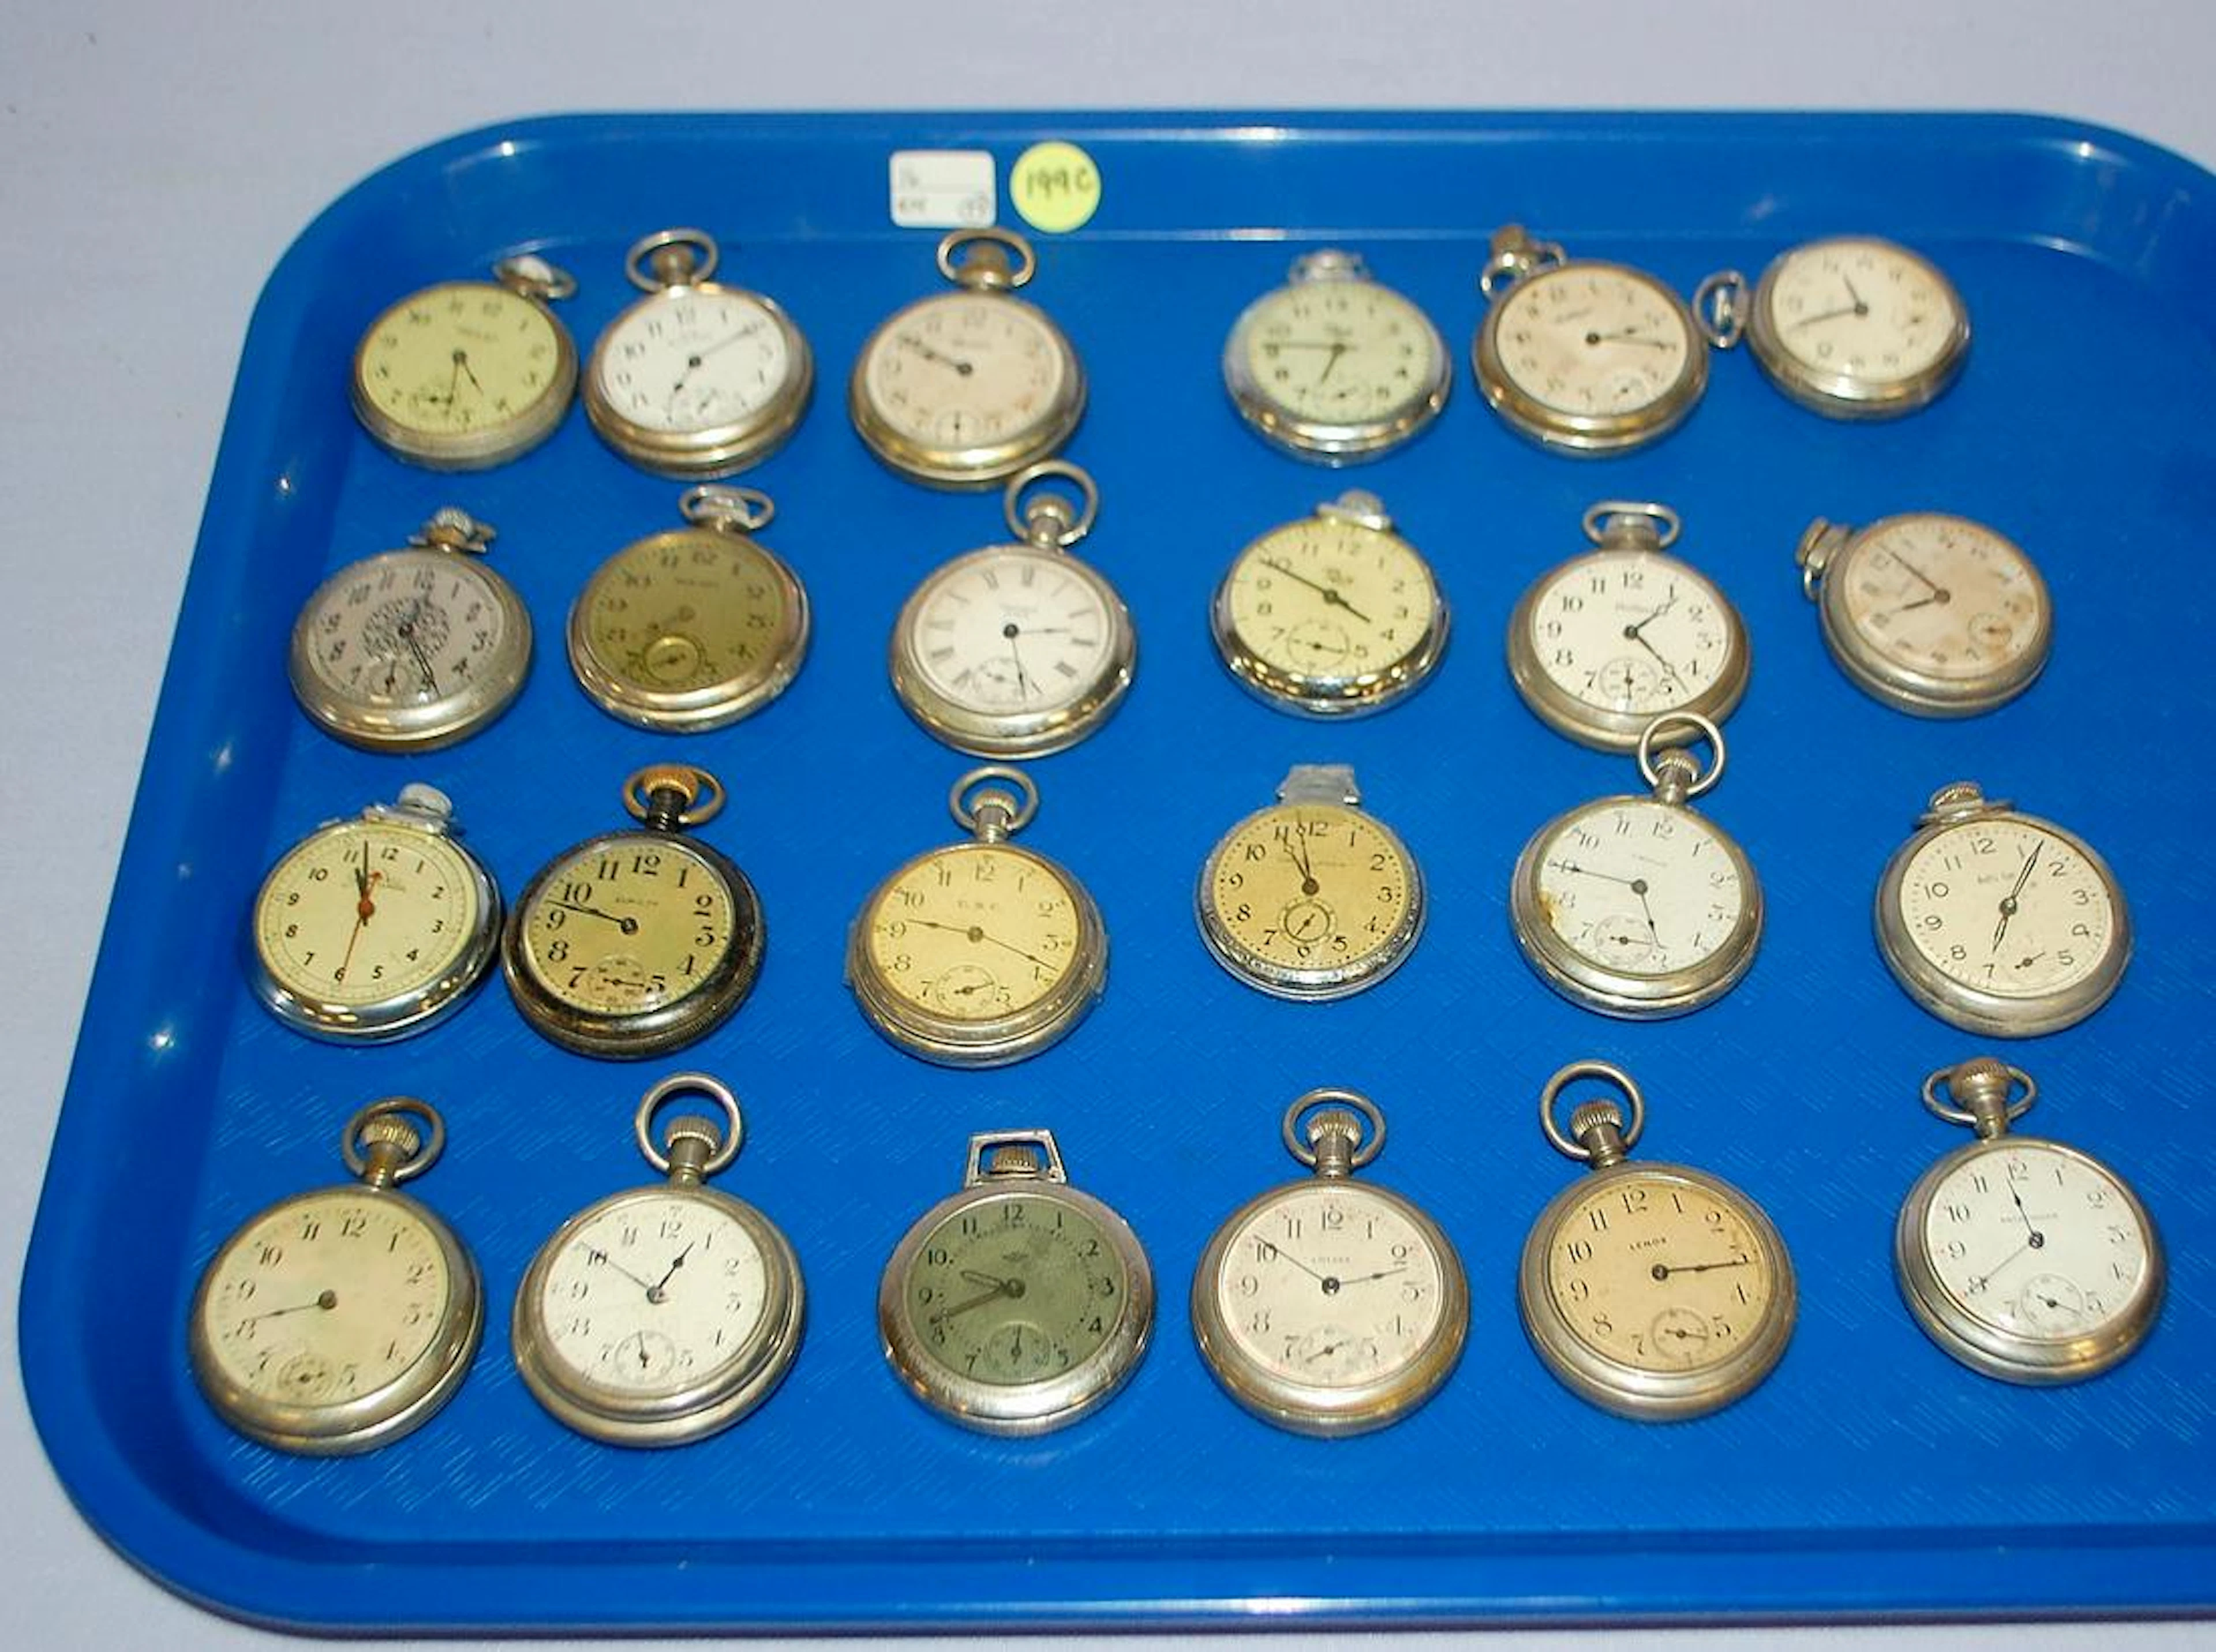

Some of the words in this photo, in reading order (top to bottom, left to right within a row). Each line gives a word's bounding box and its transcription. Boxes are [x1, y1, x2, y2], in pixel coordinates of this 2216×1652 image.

[1301, 542, 1319, 556] 11
[1338, 540, 1361, 556] 12
[1592, 579, 1606, 594] 11
[1623, 572, 1644, 590] 12
[1669, 584, 1675, 598] 1
[1562, 596, 1583, 612] 10
[1689, 605, 1704, 622] 2
[1381, 628, 1395, 641] 4
[1547, 620, 1562, 638] 9
[1555, 649, 1573, 666] 8
[1584, 671, 1596, 688] 7
[1274, 826, 1289, 841] 11
[1308, 822, 1328, 837] 12
[1615, 820, 1631, 835] 11
[1653, 821, 1674, 840] 12
[1349, 831, 1356, 847] 1
[1578, 833, 1600, 850] 10
[1970, 838, 1997, 855] 12
[343, 849, 360, 863] 11
[381, 847, 400, 861] 12
[1245, 844, 1266, 861] 10
[1692, 841, 1701, 857] 1
[416, 860, 424, 874] 1
[597, 860, 620, 881] 11
[631, 854, 661, 876] 12
[1370, 854, 1386, 871] 2
[1944, 856, 1962, 871] 11
[2049, 861, 2068, 877] 2
[308, 867, 330, 882] 10
[677, 868, 688, 889] 1
[938, 870, 952, 887] 11
[974, 863, 995, 882] 12
[1710, 871, 1725, 889] 2
[1019, 876, 1025, 893] 1
[1229, 874, 1244, 890] 9
[289, 892, 300, 906] 9
[432, 886, 444, 899] 2
[562, 882, 593, 903] 10
[903, 891, 924, 906] 10
[1377, 887, 1393, 903] 3
[1925, 882, 1949, 900] 10
[2072, 890, 2089, 905] 3
[694, 894, 713, 917] 2
[1559, 891, 1576, 909] 8
[1039, 902, 1054, 918] 2
[1237, 904, 1252, 921] 8
[432, 920, 444, 934] 3
[546, 910, 566, 931] 9
[1364, 915, 1377, 932] 4
[1925, 915, 1942, 931] 9
[286, 924, 298, 938] 8
[695, 926, 714, 947] 3
[889, 921, 907, 938] 9
[1264, 929, 1278, 945] 7
[1581, 923, 1594, 938] 7
[2072, 924, 2090, 937] 4
[548, 940, 569, 962] 8
[1297, 946, 1311, 958] 6
[1332, 936, 1348, 952] 5
[304, 952, 315, 966] 7
[406, 948, 420, 962] 4
[1950, 945, 1967, 961] 8
[2058, 950, 2074, 966] 5
[372, 965, 384, 979] 5
[677, 954, 694, 976] 4
[894, 955, 911, 972] 8
[1983, 964, 1996, 978] 7
[335, 967, 347, 982] 6
[568, 967, 587, 988] 7
[645, 975, 666, 993] 5
[920, 980, 934, 998] 7
[995, 987, 1011, 1003] 5
[2007, 1162, 2028, 1181] 12
[2054, 1168, 2064, 1186] 1
[1972, 1175, 1989, 1193] 11
[1622, 1190, 1648, 1213] 12
[1672, 1193, 1683, 1212] 1
[2087, 1192, 2105, 1209] 2
[1004, 1204, 1024, 1221] 12
[1056, 1212, 1063, 1229] 1
[1322, 1211, 1344, 1231] 12
[1589, 1209, 1608, 1231] 11
[1947, 1204, 1971, 1222] 10
[340, 1216, 366, 1238] 12
[660, 1221, 683, 1239] 12
[962, 1218, 977, 1235] 11
[1287, 1219, 1301, 1239] 11
[1367, 1220, 1373, 1239] 1
[1705, 1211, 1725, 1233] 2
[302, 1223, 321, 1241] 11
[622, 1227, 638, 1246] 11
[388, 1233, 399, 1253] 1
[706, 1233, 713, 1250] 1
[1085, 1239, 1099, 1256] 2
[1948, 1241, 1966, 1258] 9
[259, 1247, 282, 1267] 10
[587, 1249, 608, 1266] 10
[927, 1249, 947, 1265] 10
[1256, 1243, 1278, 1263] 10
[1391, 1244, 1408, 1265] 2
[1567, 1239, 1593, 1264] 10
[405, 1265, 424, 1284] 2
[725, 1258, 739, 1277] 2
[239, 1280, 256, 1299] 9
[571, 1282, 589, 1299] 9
[1100, 1278, 1114, 1296] 3
[1242, 1275, 1258, 1297] 9
[1570, 1279, 1589, 1302] 9
[918, 1287, 933, 1304] 9
[1087, 1317, 1102, 1333] 4
[1253, 1312, 1270, 1333] 8
[1593, 1312, 1612, 1336] 8
[1712, 1314, 1731, 1339] 5
[932, 1328, 945, 1344] 8
[1631, 1333, 1645, 1355] 7
[1284, 1336, 1300, 1359] 7
[965, 1354, 978, 1370] 7
[1057, 1350, 1068, 1365] 5
